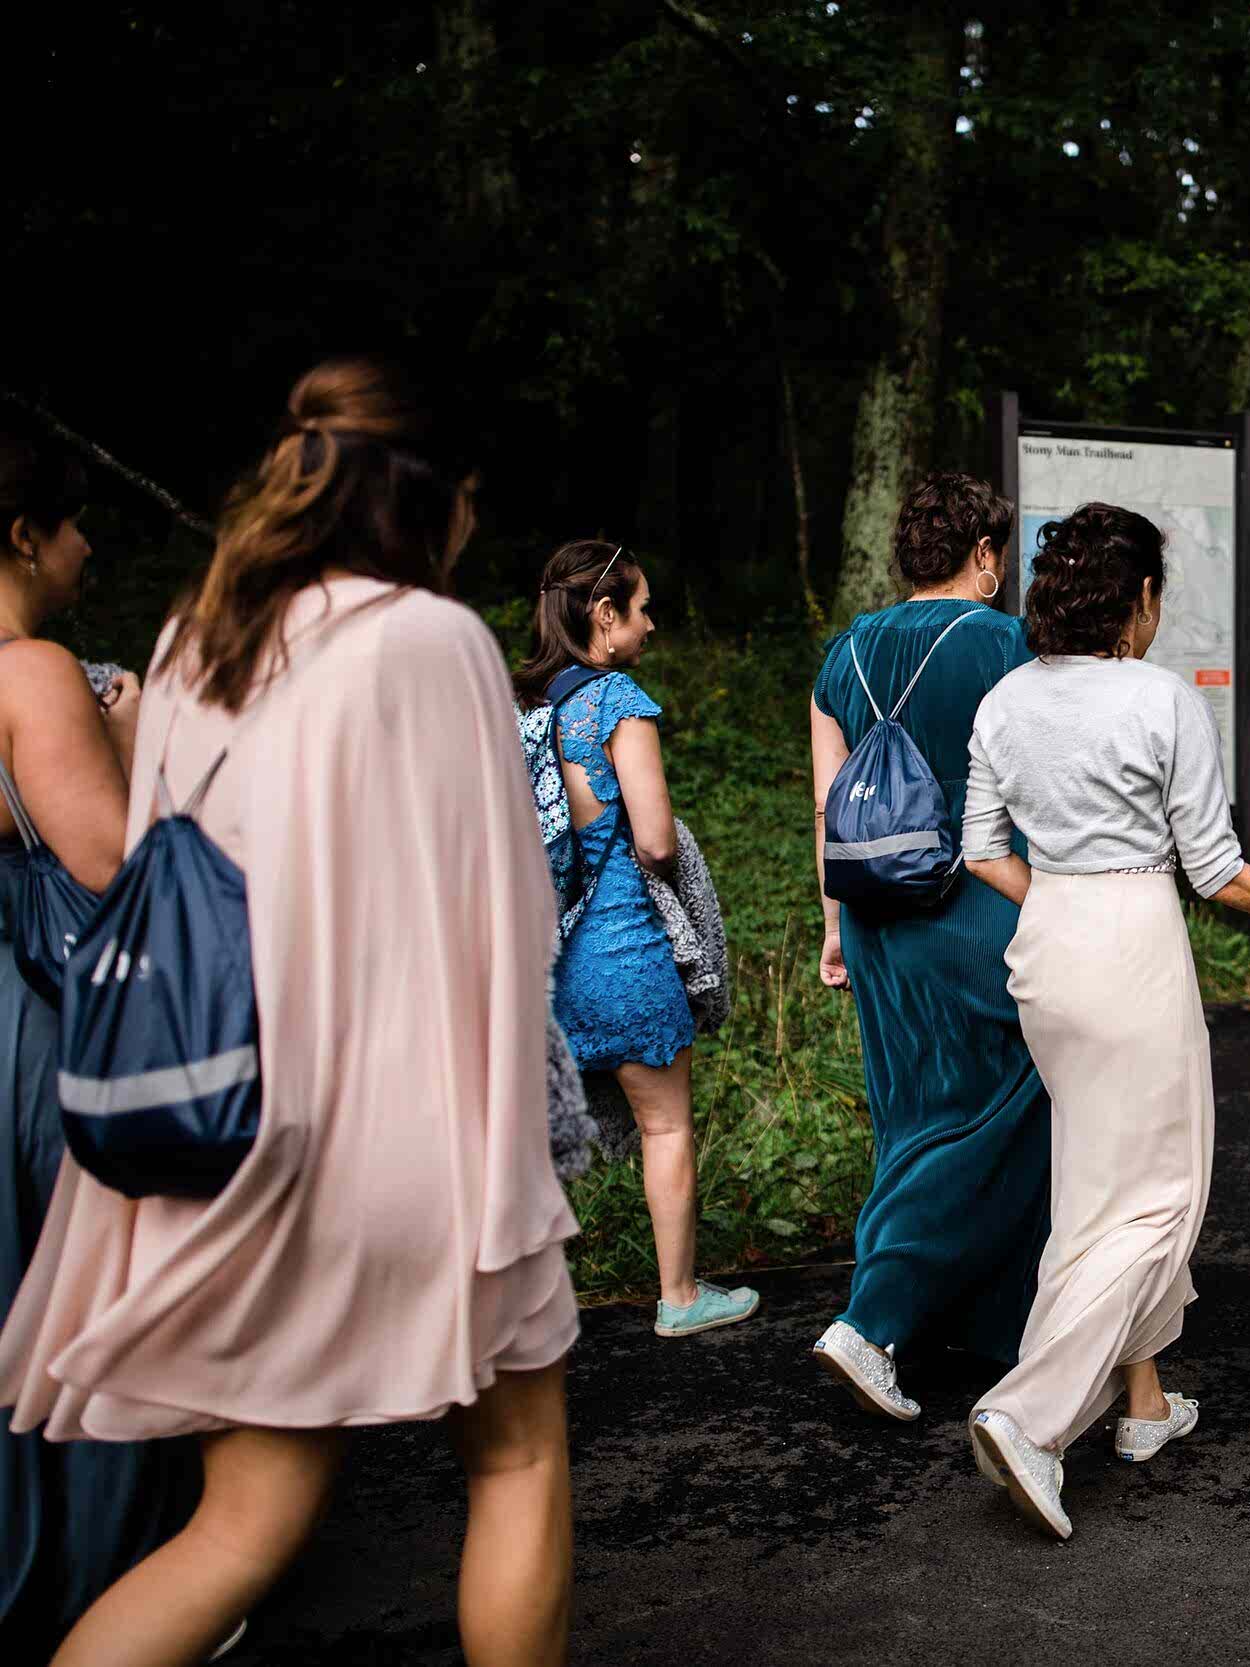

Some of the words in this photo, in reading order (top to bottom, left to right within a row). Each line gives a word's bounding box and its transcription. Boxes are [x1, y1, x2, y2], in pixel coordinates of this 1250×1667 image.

[1022, 443, 1052, 458] Stony
[1056, 445, 1080, 457] Man
[1084, 447, 1133, 460] Trailhead
